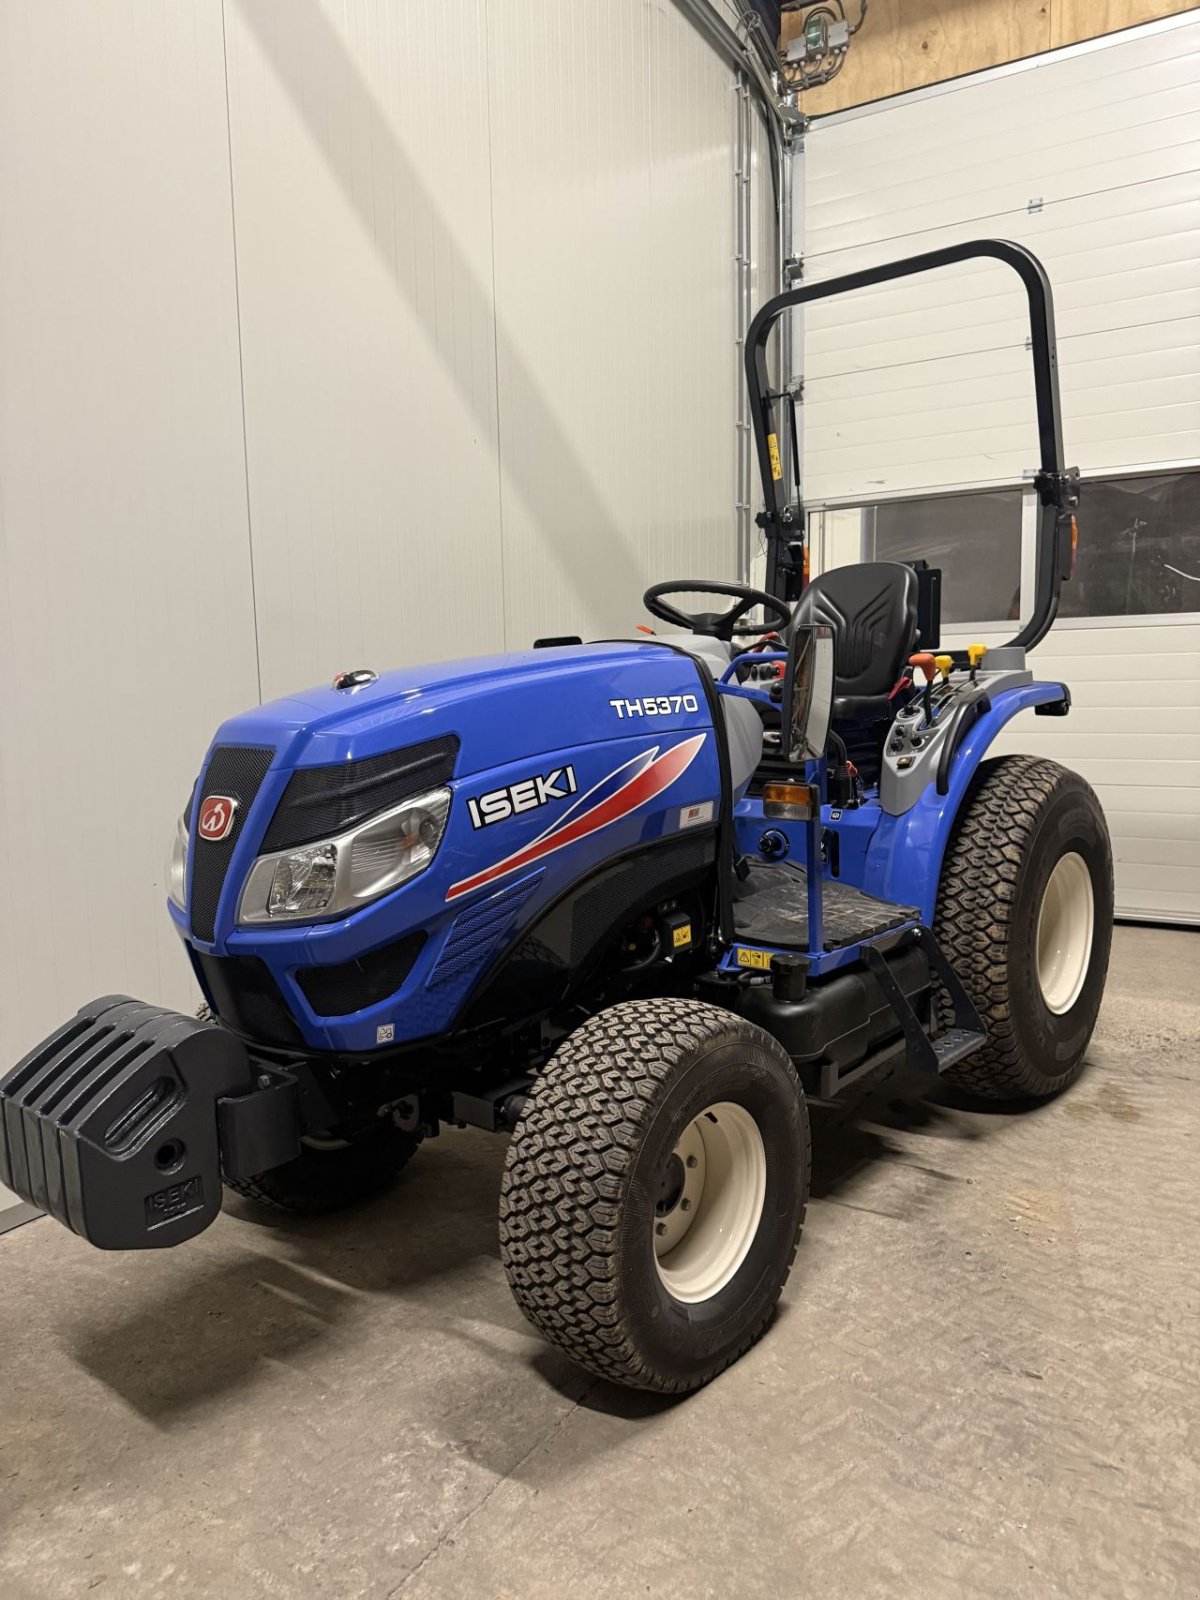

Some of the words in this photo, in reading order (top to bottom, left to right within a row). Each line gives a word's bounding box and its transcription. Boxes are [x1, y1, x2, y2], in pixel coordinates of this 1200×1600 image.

[609, 694, 699, 719] TH5370
[467, 765, 578, 829] ISEKI
[146, 1177, 200, 1212] ISEKI
